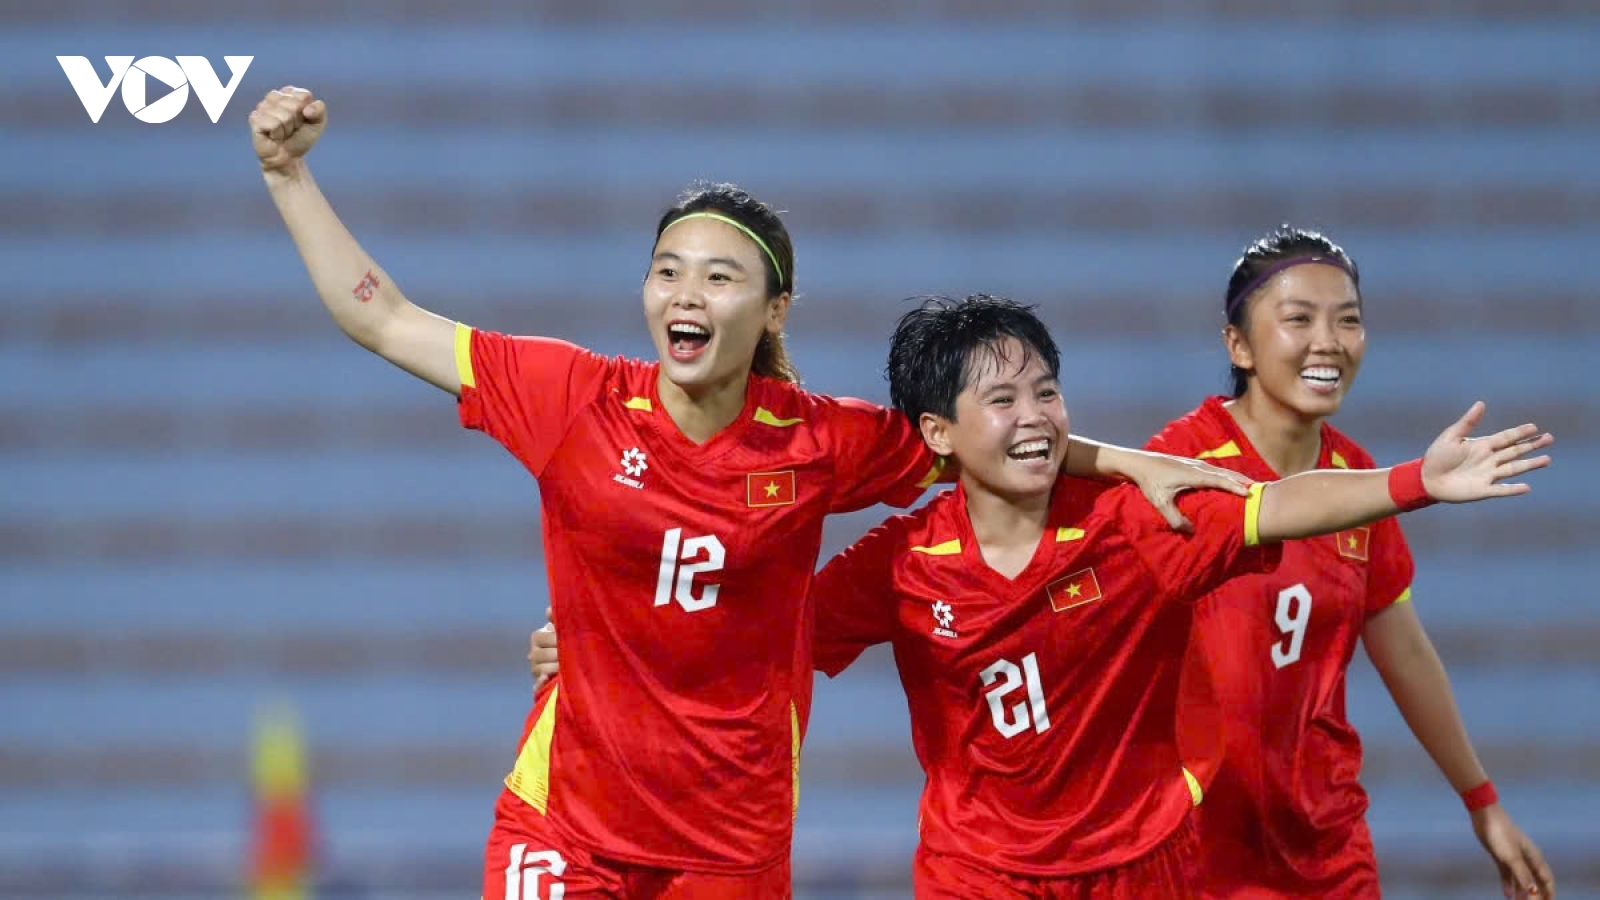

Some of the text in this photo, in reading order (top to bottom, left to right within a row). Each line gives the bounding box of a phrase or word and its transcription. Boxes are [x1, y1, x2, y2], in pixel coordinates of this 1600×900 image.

[653, 527, 726, 612] 12
[1271, 584, 1312, 669] 9
[979, 652, 1050, 738] 21
[504, 843, 567, 900] 12
